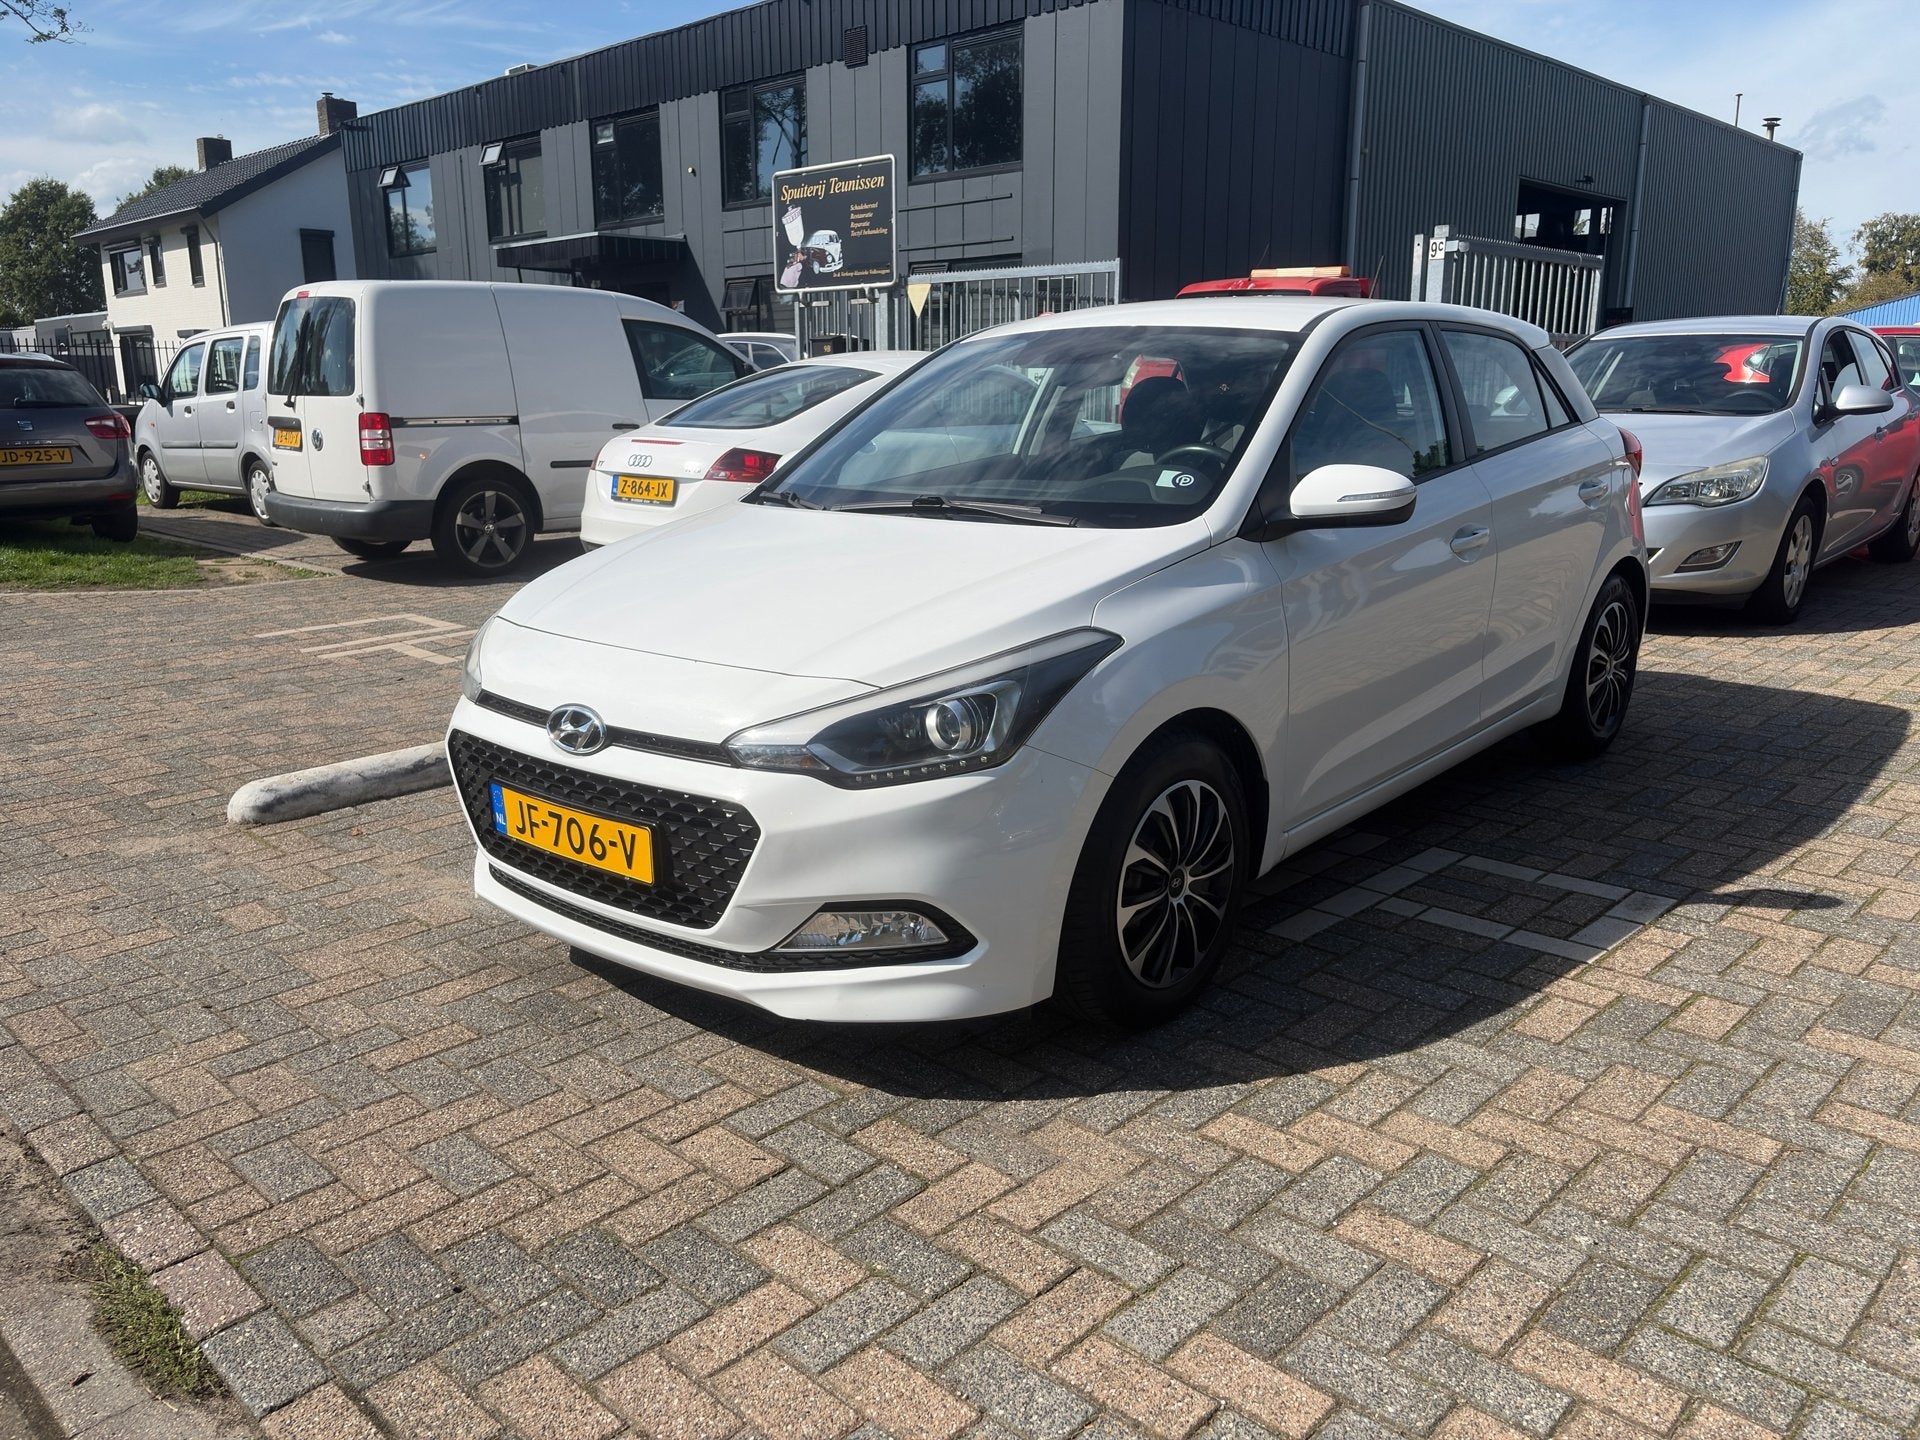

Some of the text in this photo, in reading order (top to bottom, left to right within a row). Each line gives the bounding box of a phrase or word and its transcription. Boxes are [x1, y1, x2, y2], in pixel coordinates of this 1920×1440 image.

[781, 175, 885, 204] Spuiterij Teunissen
[850, 201, 879, 210] Schadeherstel
[850, 221, 871, 229] Reparatie
[2, 449, 66, 463] JD-925-V
[620, 479, 669, 498] Z-864-JX
[495, 800, 637, 870] NL JF-706-V
